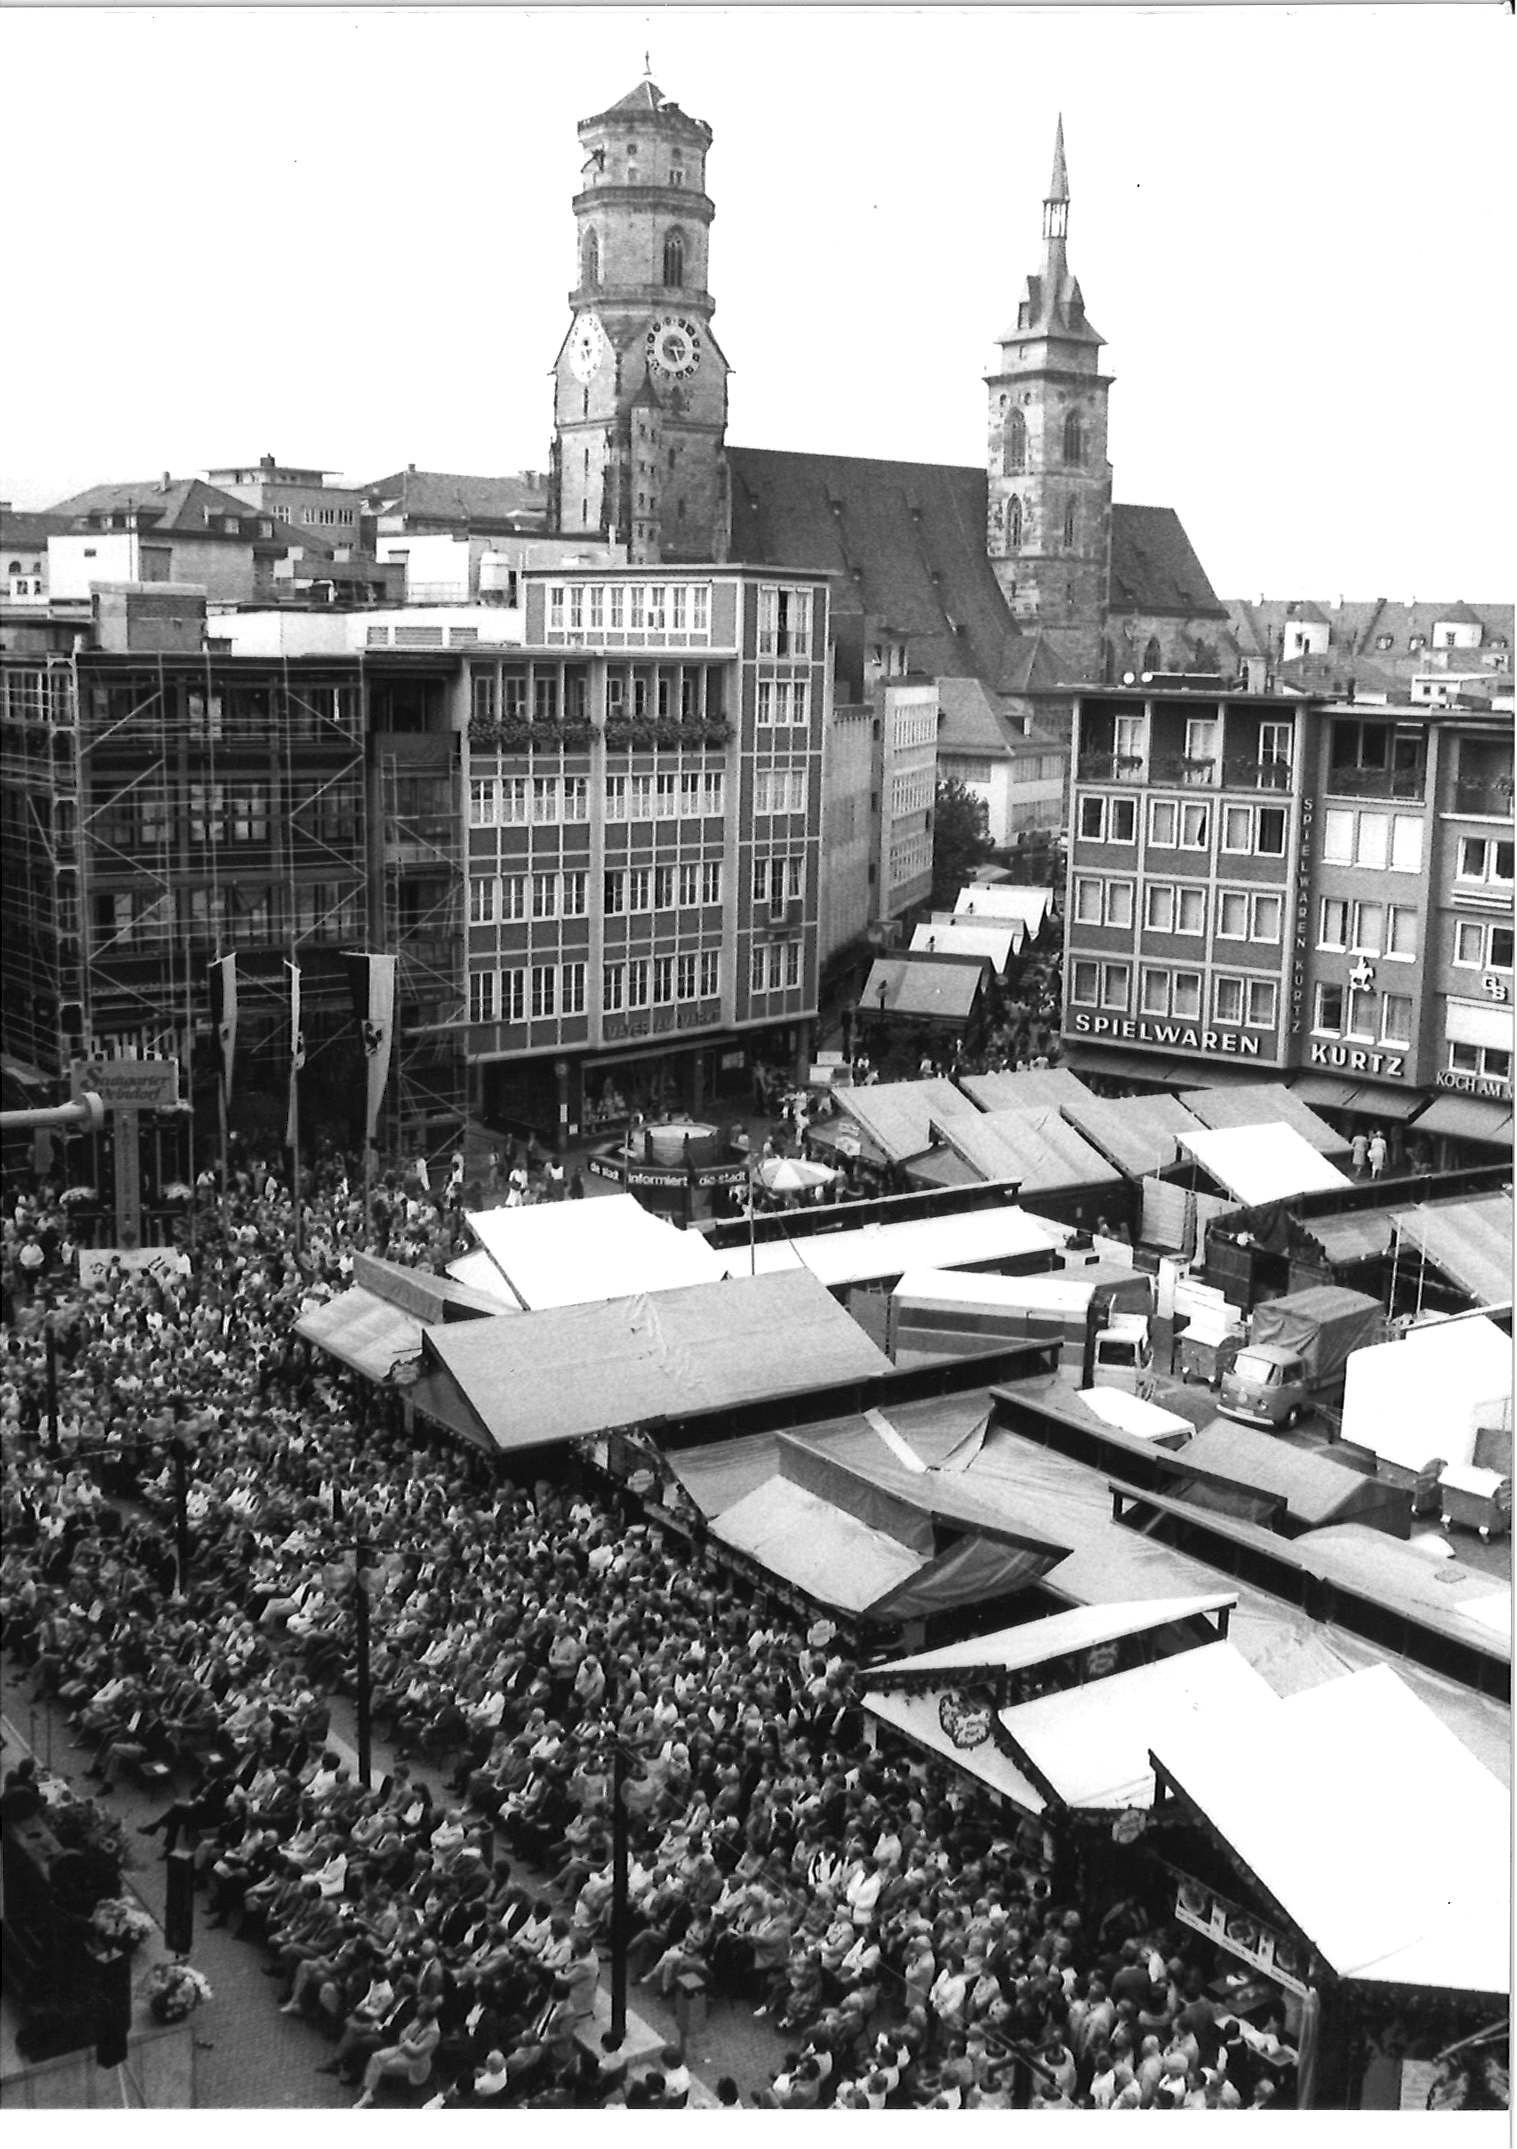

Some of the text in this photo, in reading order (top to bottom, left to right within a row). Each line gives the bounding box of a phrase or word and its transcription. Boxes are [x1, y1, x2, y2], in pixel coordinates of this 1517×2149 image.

[1292, 800, 1313, 1033] SPIELWAREN KURTZ
[1075, 1013, 1260, 1054] SPIELWAREN
[1311, 1043, 1403, 1076] KURTZ
[1436, 1071, 1476, 1093] KOCH
[1480, 1081, 1500, 1097] AM
[628, 1173, 688, 1187] informiert
[718, 1170, 746, 1185] stadt
